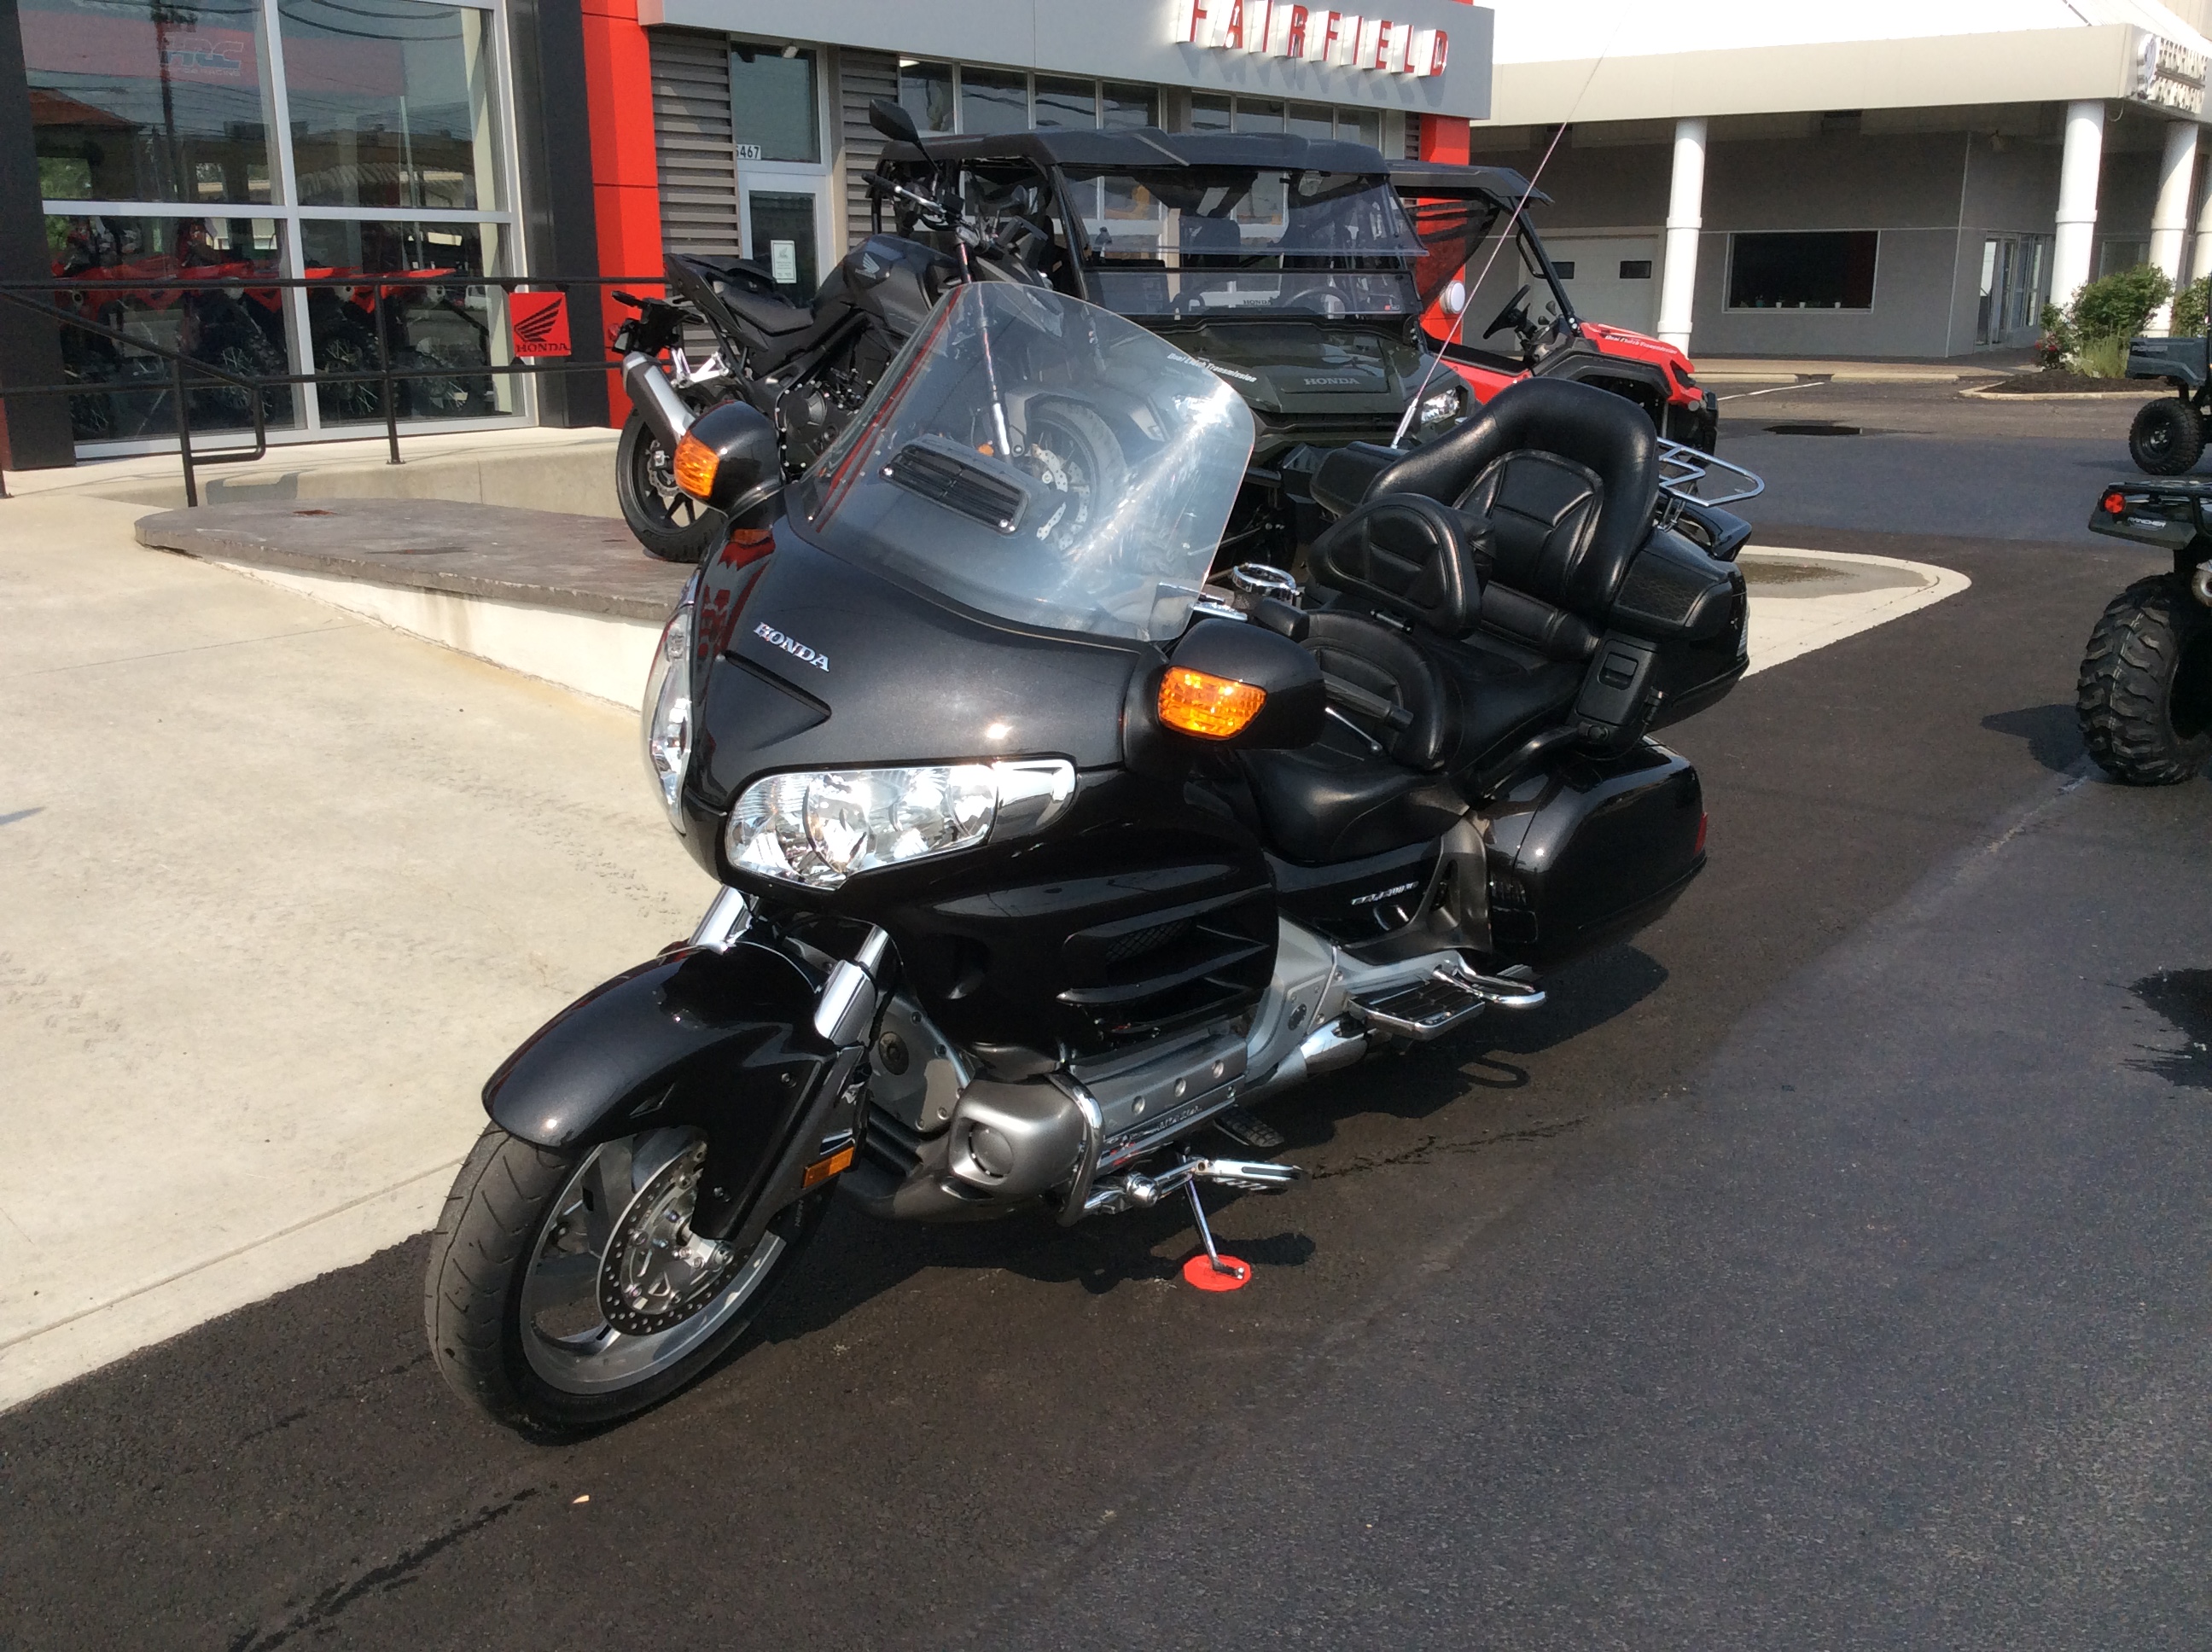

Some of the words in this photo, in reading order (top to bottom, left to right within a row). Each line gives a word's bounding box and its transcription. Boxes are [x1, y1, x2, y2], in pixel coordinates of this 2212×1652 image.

[1190, 0, 1450, 78] FAIRFIELD
[516, 342, 571, 352] HONDA
[1167, 352, 1185, 362] Dual
[1206, 362, 1257, 383] Transmission
[1303, 377, 1363, 386] HONDA
[753, 621, 830, 672] HONDA
